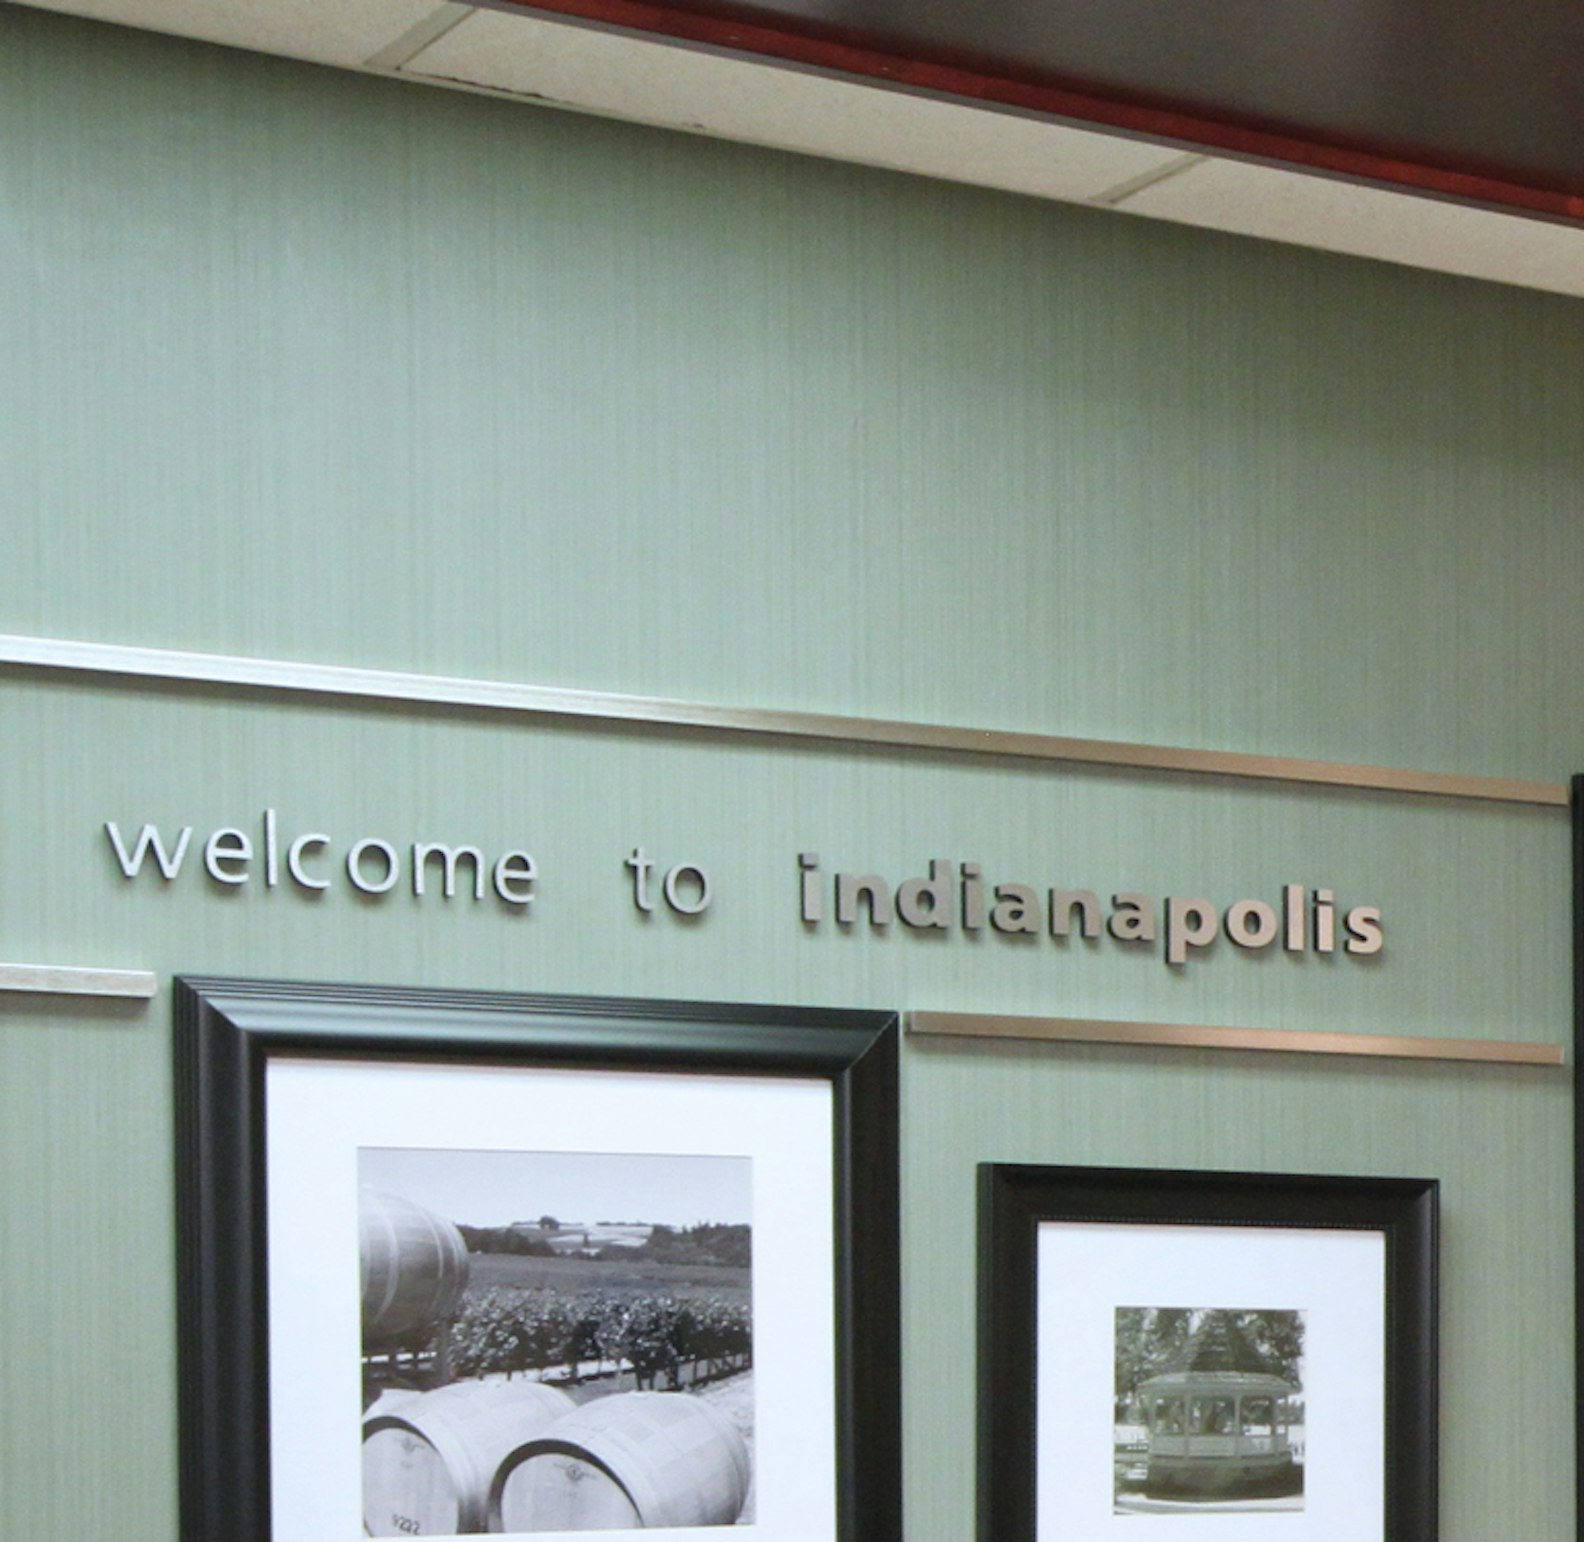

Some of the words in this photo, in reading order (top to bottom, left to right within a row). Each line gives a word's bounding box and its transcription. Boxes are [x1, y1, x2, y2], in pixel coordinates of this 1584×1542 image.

[104, 808, 538, 904] welcome
[625, 846, 713, 914] to
[796, 852, 1384, 964] indianapolis
